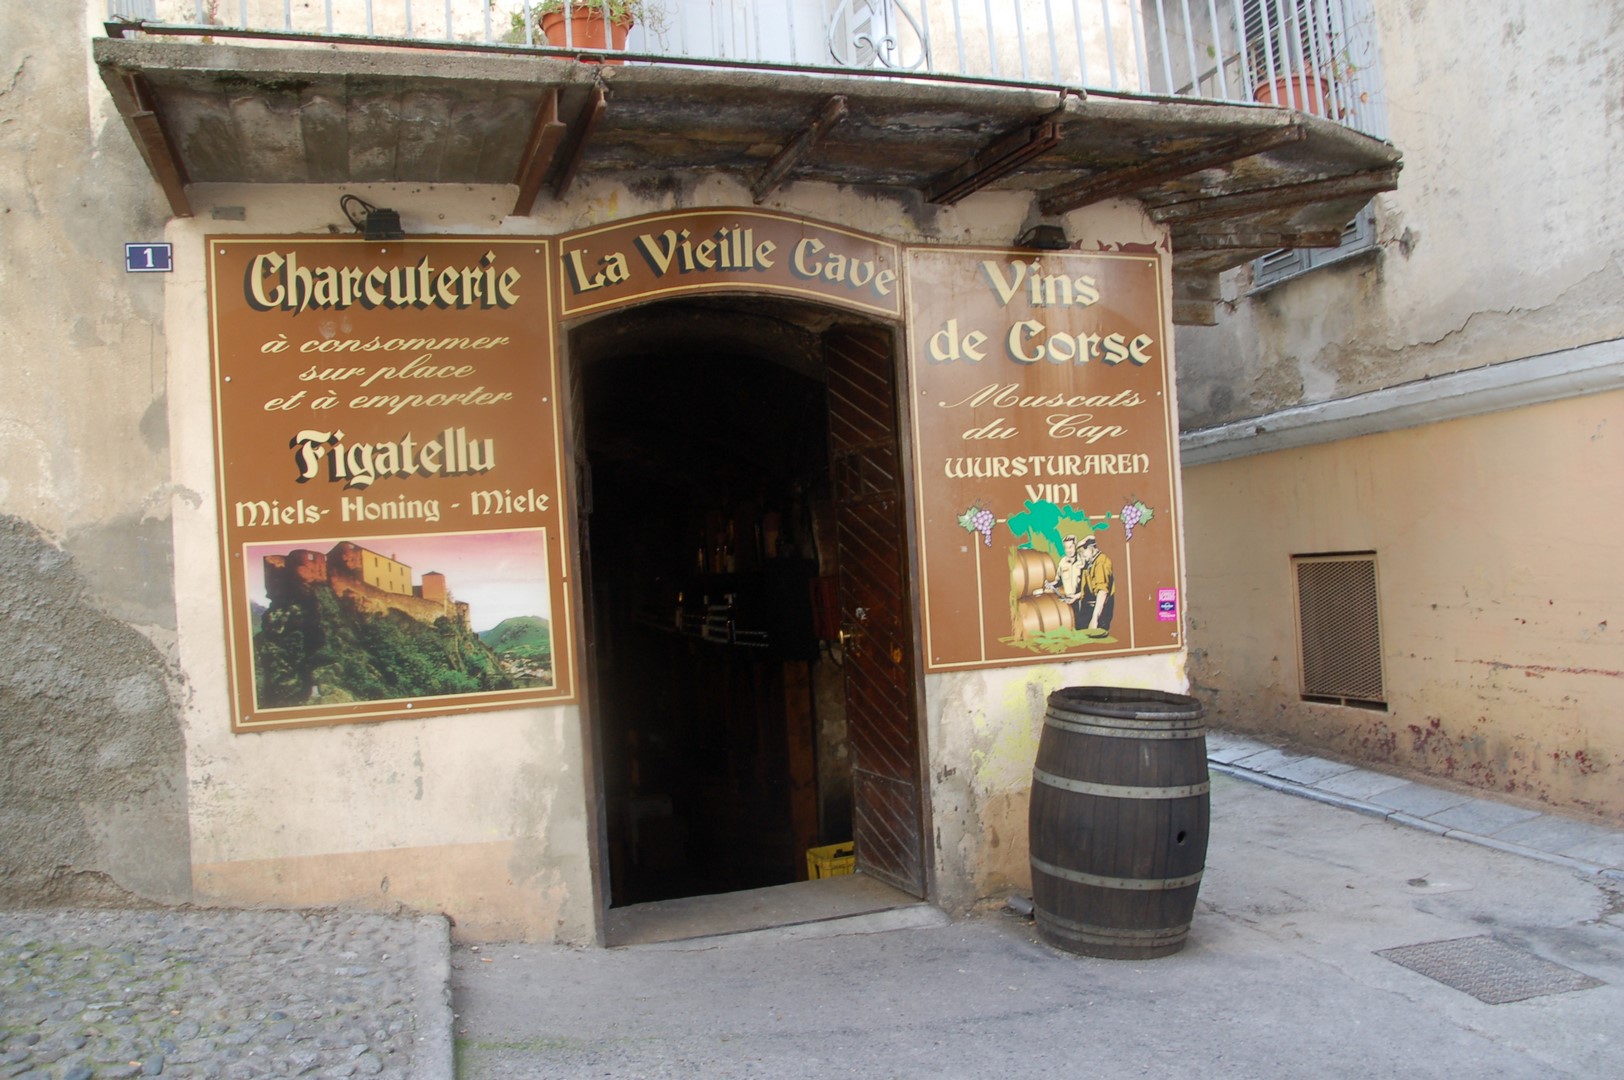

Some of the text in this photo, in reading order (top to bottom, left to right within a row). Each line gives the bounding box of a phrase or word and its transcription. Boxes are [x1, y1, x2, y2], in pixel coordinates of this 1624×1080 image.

[142, 248, 154, 268] 1
[570, 223, 898, 296] La Vieille Cave
[249, 250, 521, 313] Charcuterie
[982, 259, 1100, 306] Vins
[261, 333, 511, 354] à consommer
[929, 318, 1154, 364] de Corse
[298, 353, 477, 389] sur place
[263, 386, 513, 416] et à emporter
[938, 383, 1147, 409] Muscats
[961, 413, 1129, 444] du Cap
[295, 427, 497, 487] Figatellu
[340, 495, 440, 523] Honing
[470, 488, 550, 516] Miele
[1024, 483, 1079, 504] VINI
